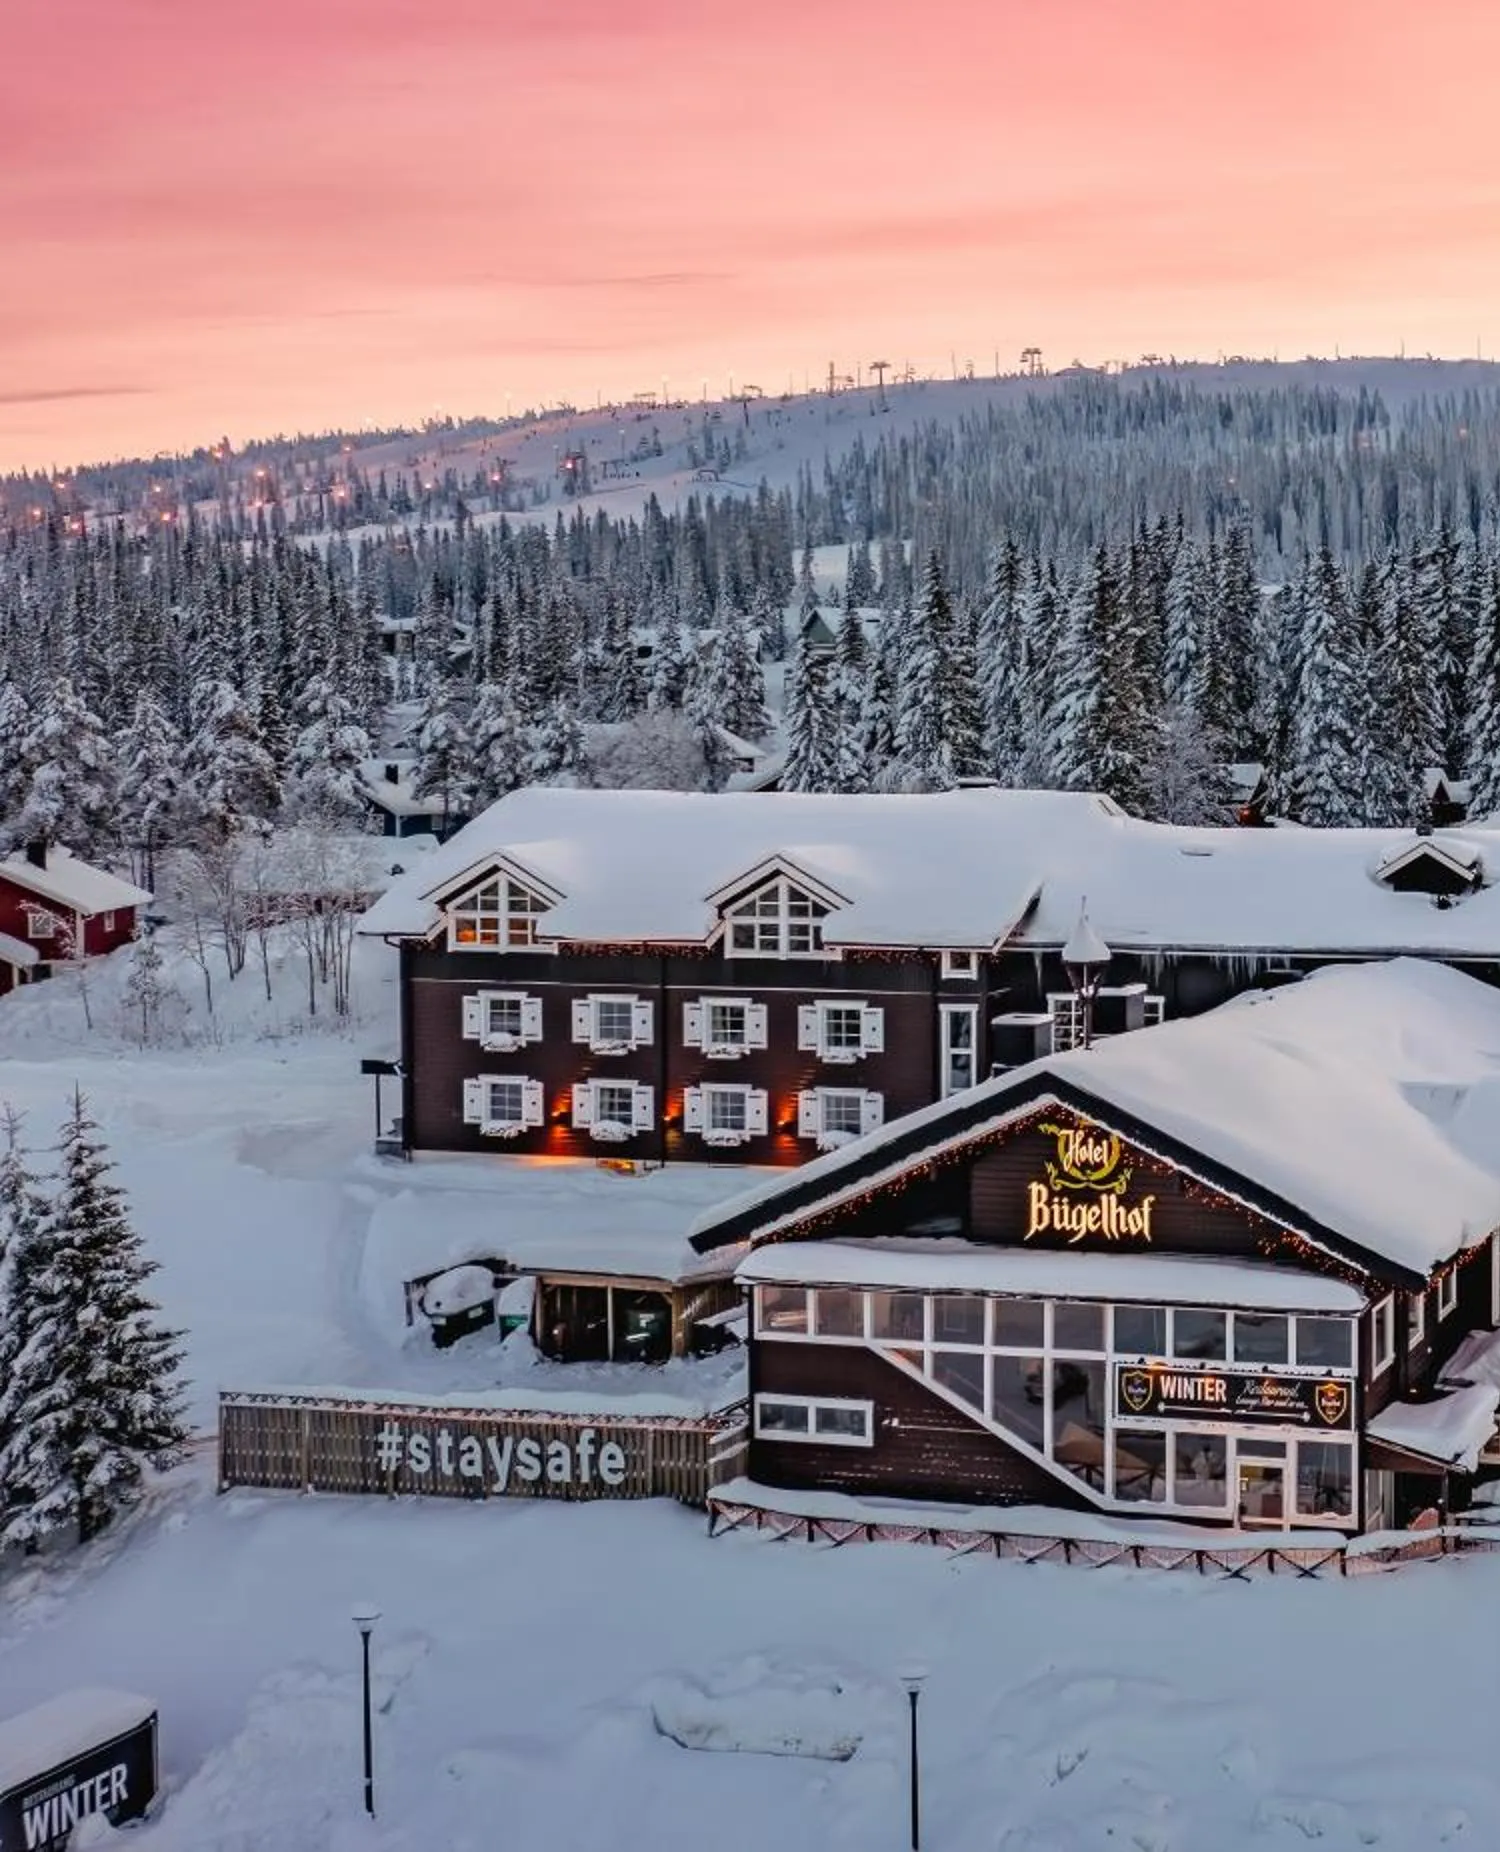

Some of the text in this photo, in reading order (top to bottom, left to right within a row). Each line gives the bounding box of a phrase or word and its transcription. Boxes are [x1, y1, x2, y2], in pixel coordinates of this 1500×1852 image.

[1058, 1128, 1108, 1171] Hotel
[1024, 1180, 1156, 1243] Bügelhof
[1160, 1375, 1227, 1402] WINTER
[377, 1421, 626, 1492] #staysafe
[23, 1763, 129, 1850] WINTER
